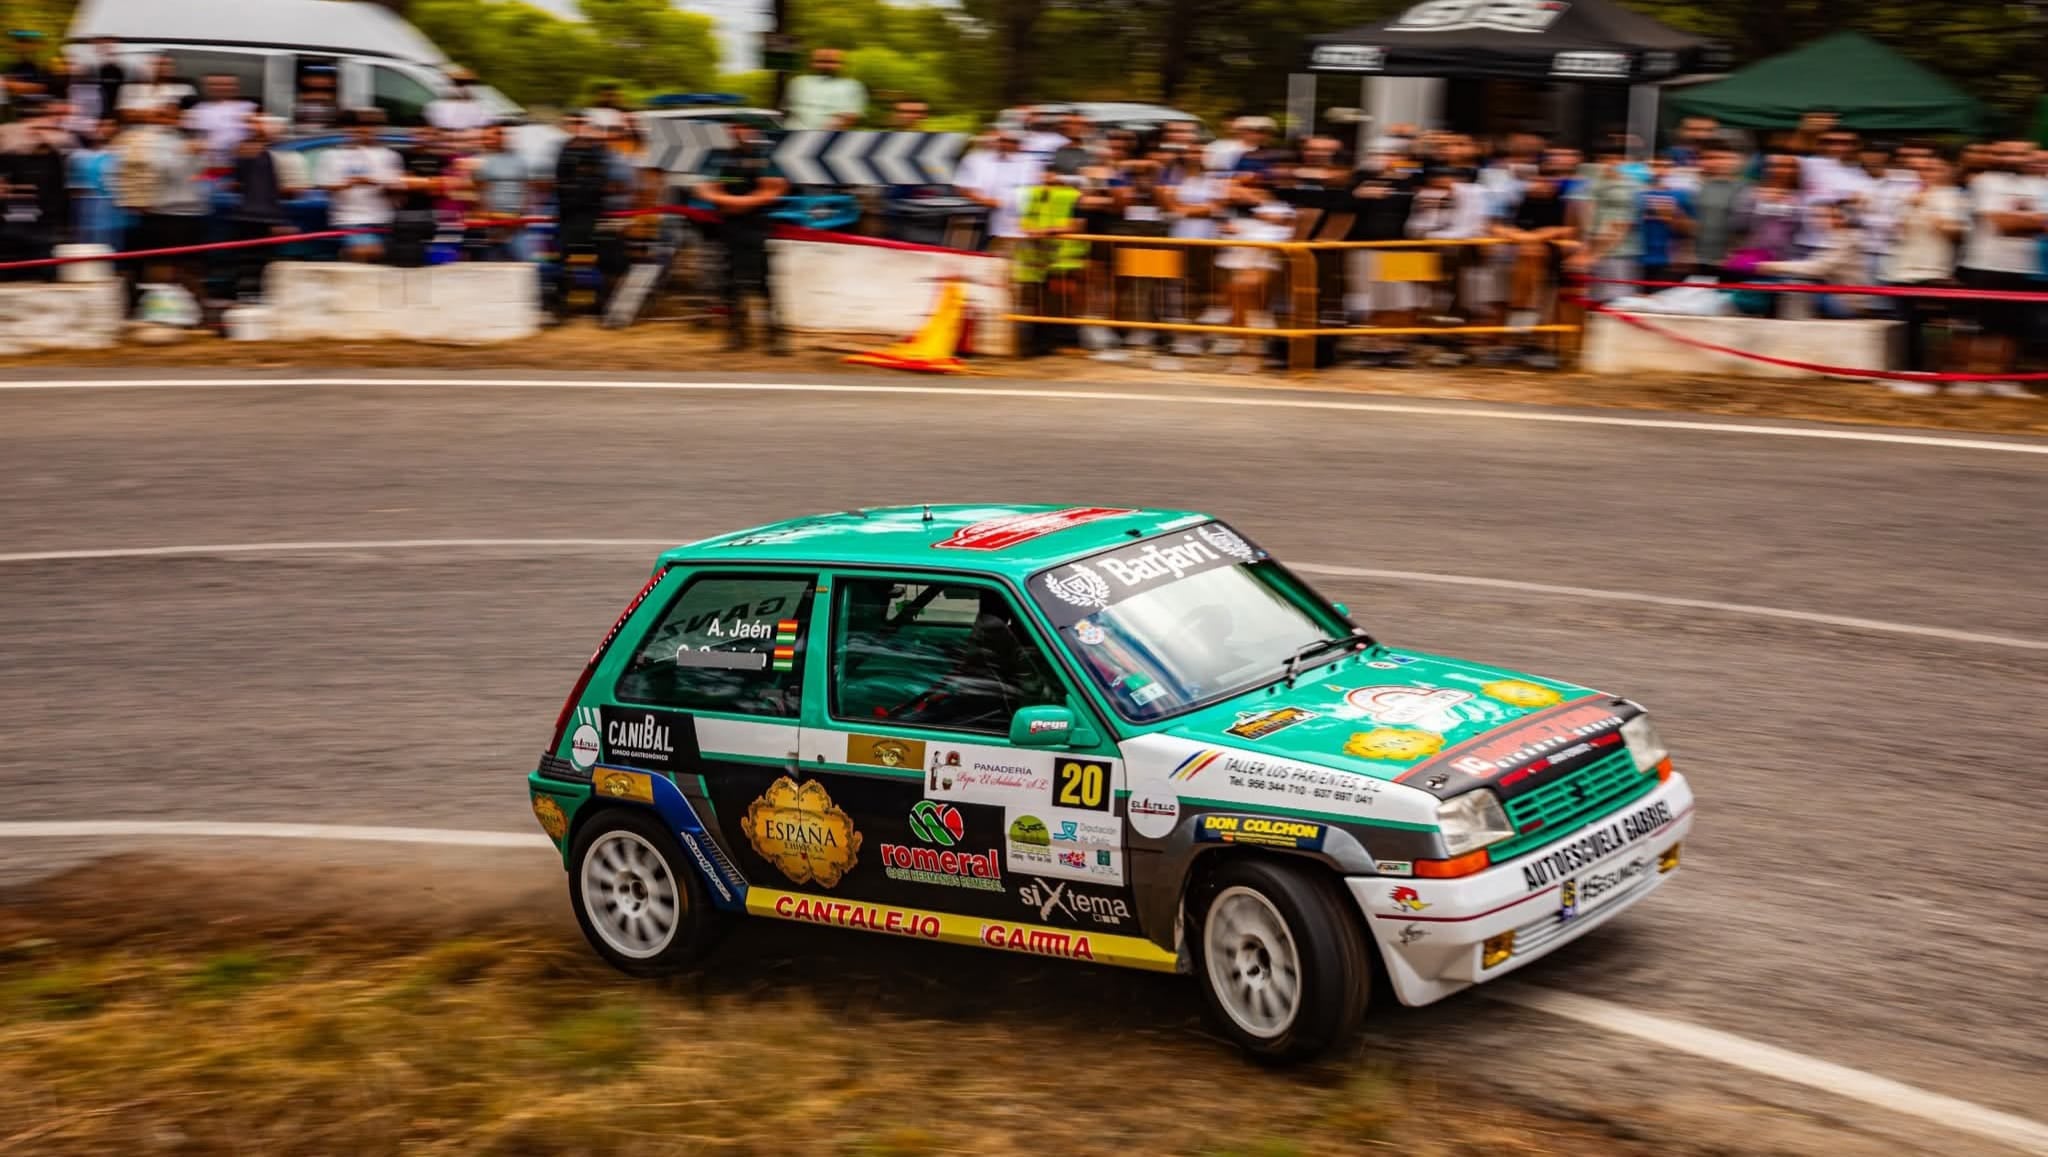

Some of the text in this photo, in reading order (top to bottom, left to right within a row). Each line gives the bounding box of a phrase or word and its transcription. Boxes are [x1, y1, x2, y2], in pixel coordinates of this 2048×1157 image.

[1098, 535, 1220, 586] Barjavi
[707, 618, 772, 639] A. Jaén
[608, 713, 674, 753] CANIBAL
[974, 762, 1033, 776] PANADERÍA
[1224, 758, 1263, 776] TALLER
[1267, 764, 1289, 779] LOS
[1060, 762, 1104, 807] 20
[1248, 779, 1265, 790] 956
[1268, 782, 1286, 792] 344
[1288, 784, 1306, 795] 710
[765, 820, 838, 848] ESPAÑA
[1204, 816, 1319, 839] DON COLCHON
[880, 843, 1001, 879] romeral
[775, 896, 942, 939] CANTALEJO
